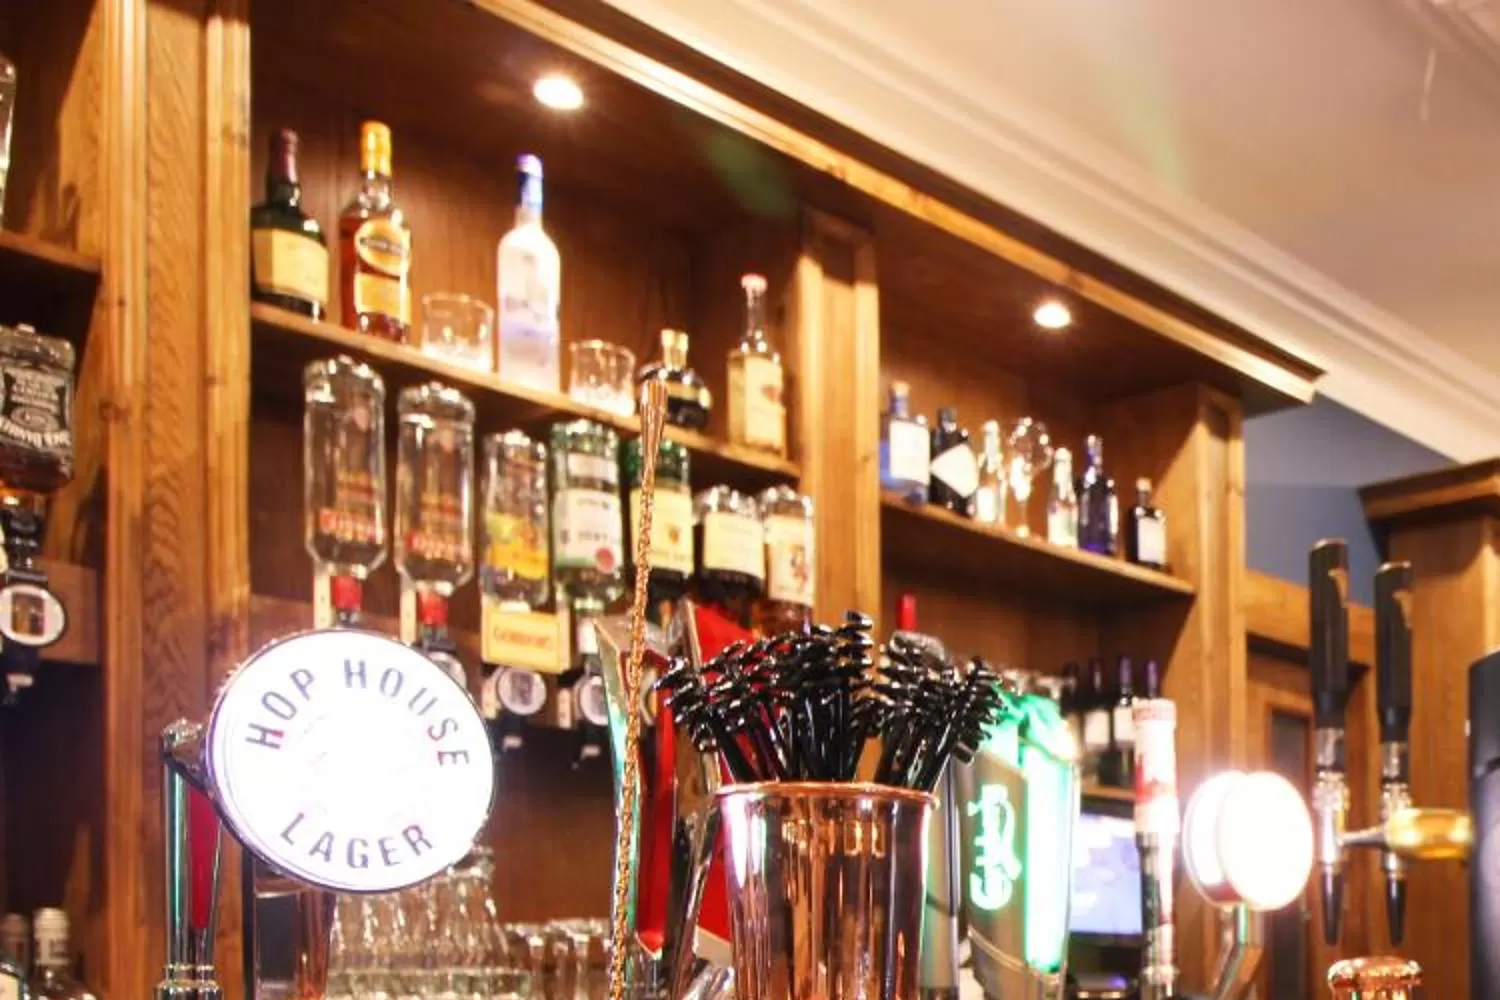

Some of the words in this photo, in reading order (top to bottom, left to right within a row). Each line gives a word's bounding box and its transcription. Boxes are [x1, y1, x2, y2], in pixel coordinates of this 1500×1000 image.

[245, 668, 316, 749] HOP
[343, 659, 470, 766] HOUSE
[280, 812, 433, 869] LAGER
